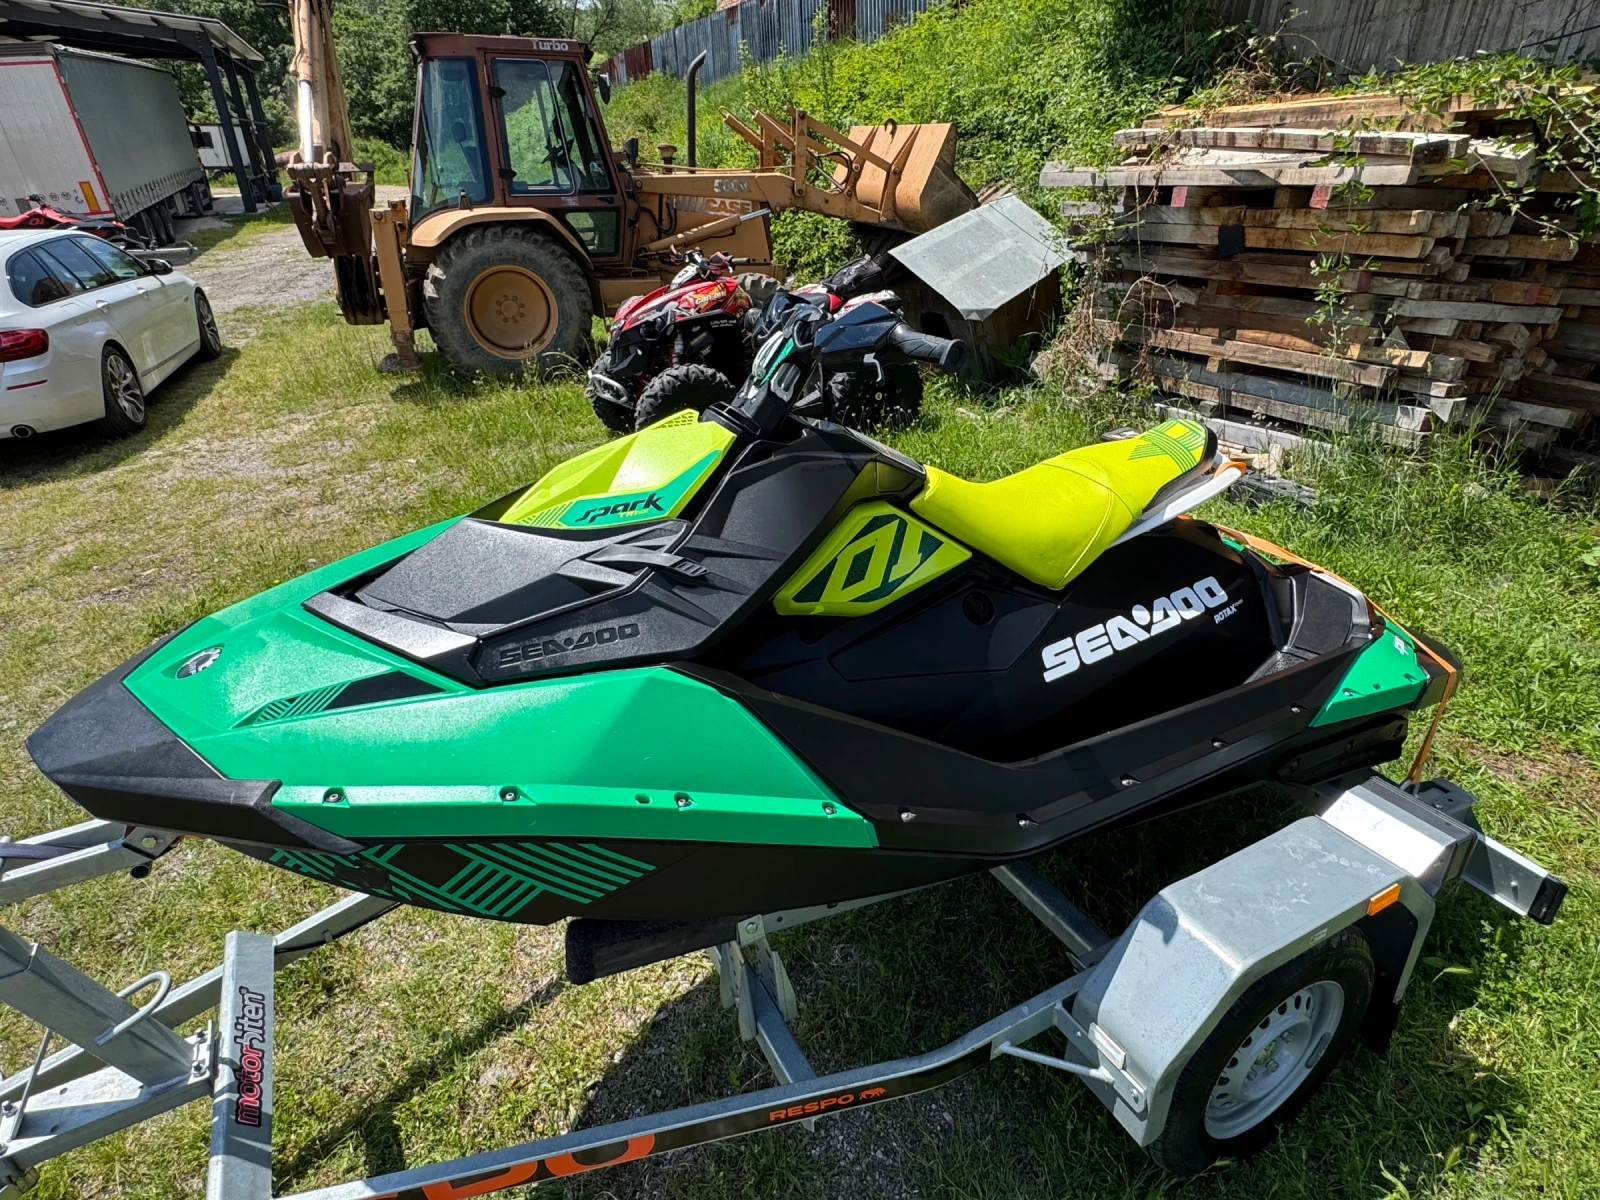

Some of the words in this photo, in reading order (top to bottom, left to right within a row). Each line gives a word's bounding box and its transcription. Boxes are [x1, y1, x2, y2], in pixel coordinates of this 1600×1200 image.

[530, 39, 569, 51] Turbo
[704, 198, 752, 215] CASE
[574, 492, 665, 524] spark
[1213, 603, 1238, 625] ROTAX
[769, 1094, 855, 1122] RESPO
